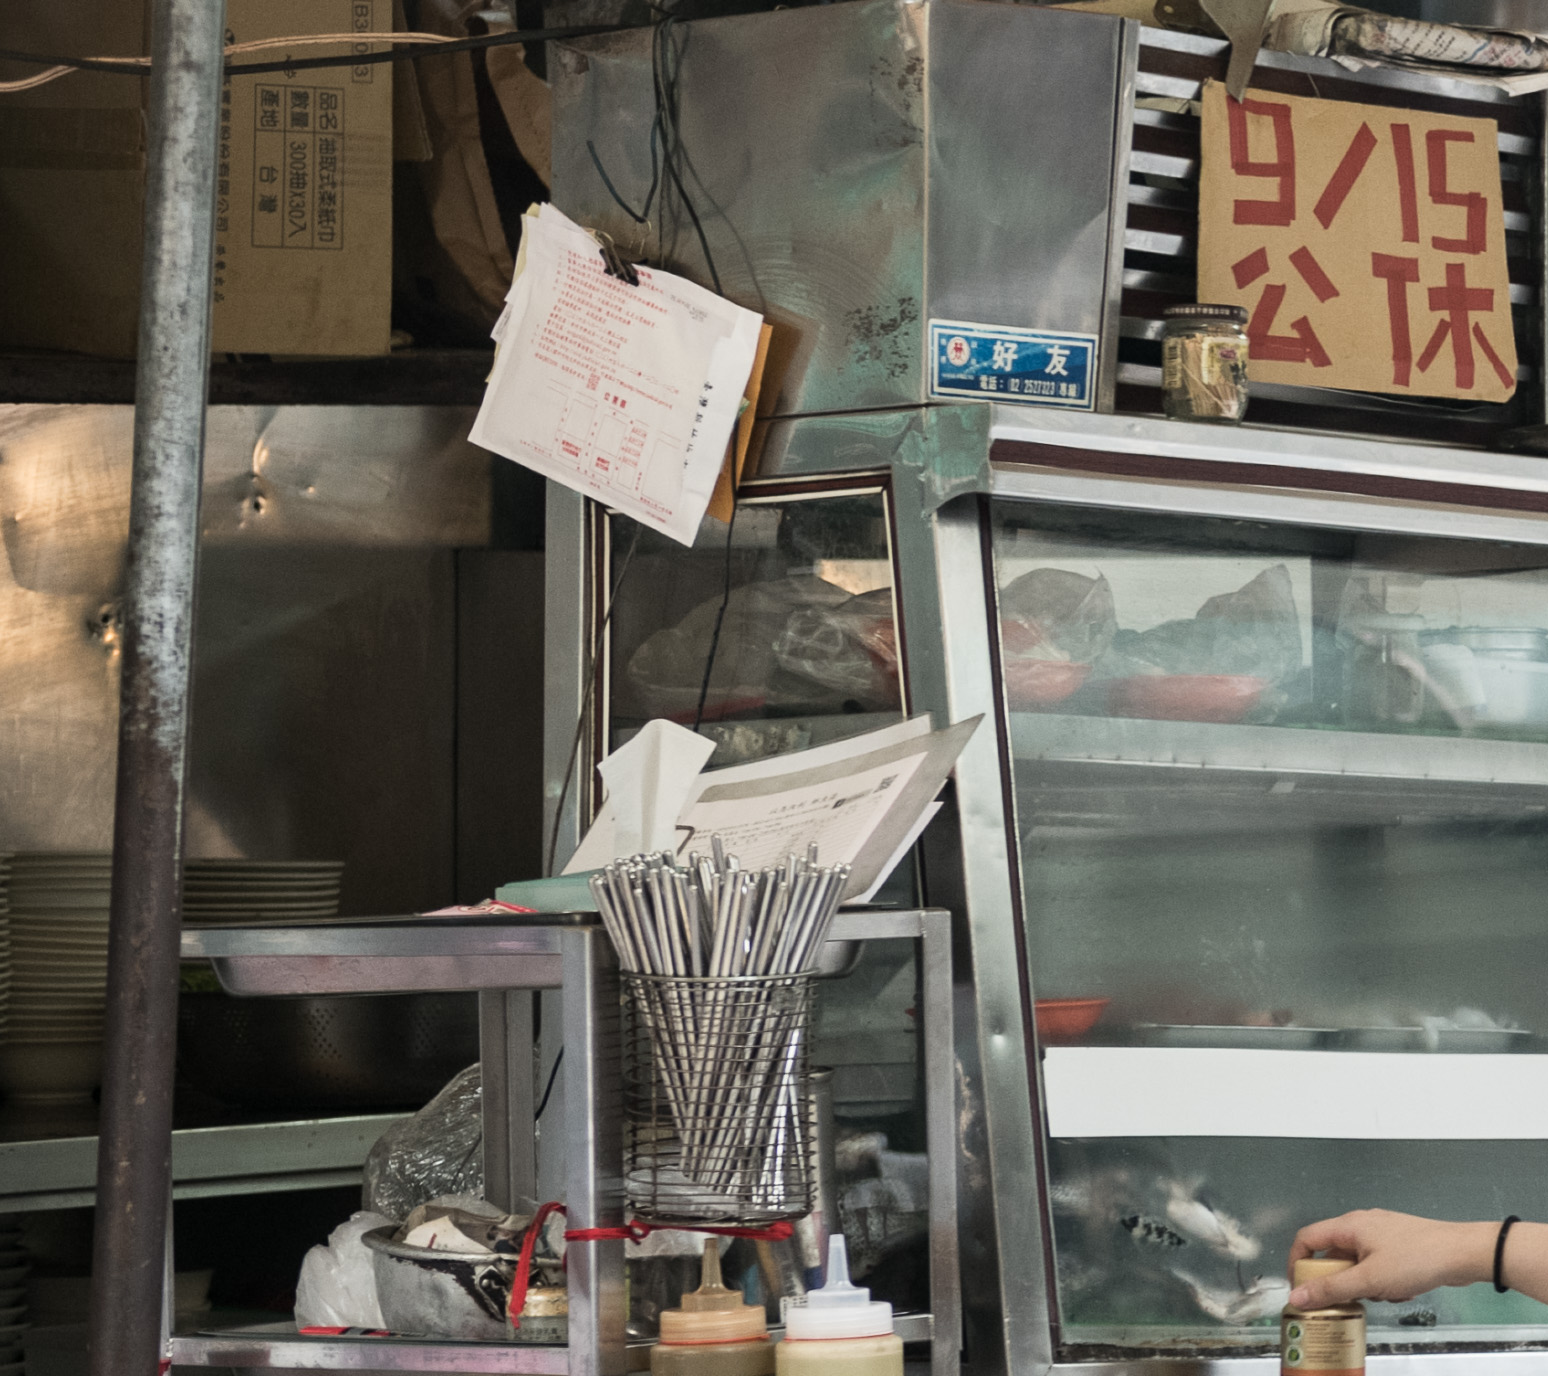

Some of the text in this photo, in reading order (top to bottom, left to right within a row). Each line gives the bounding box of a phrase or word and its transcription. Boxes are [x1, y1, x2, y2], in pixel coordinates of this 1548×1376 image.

[353, 4, 370, 78] B303
[316, 91, 338, 244] 品名 抽取式柔紙巾
[1229, 97, 1488, 256] 9/15
[991, 341, 1071, 377] 好友
[1231, 246, 1517, 391] 公休
